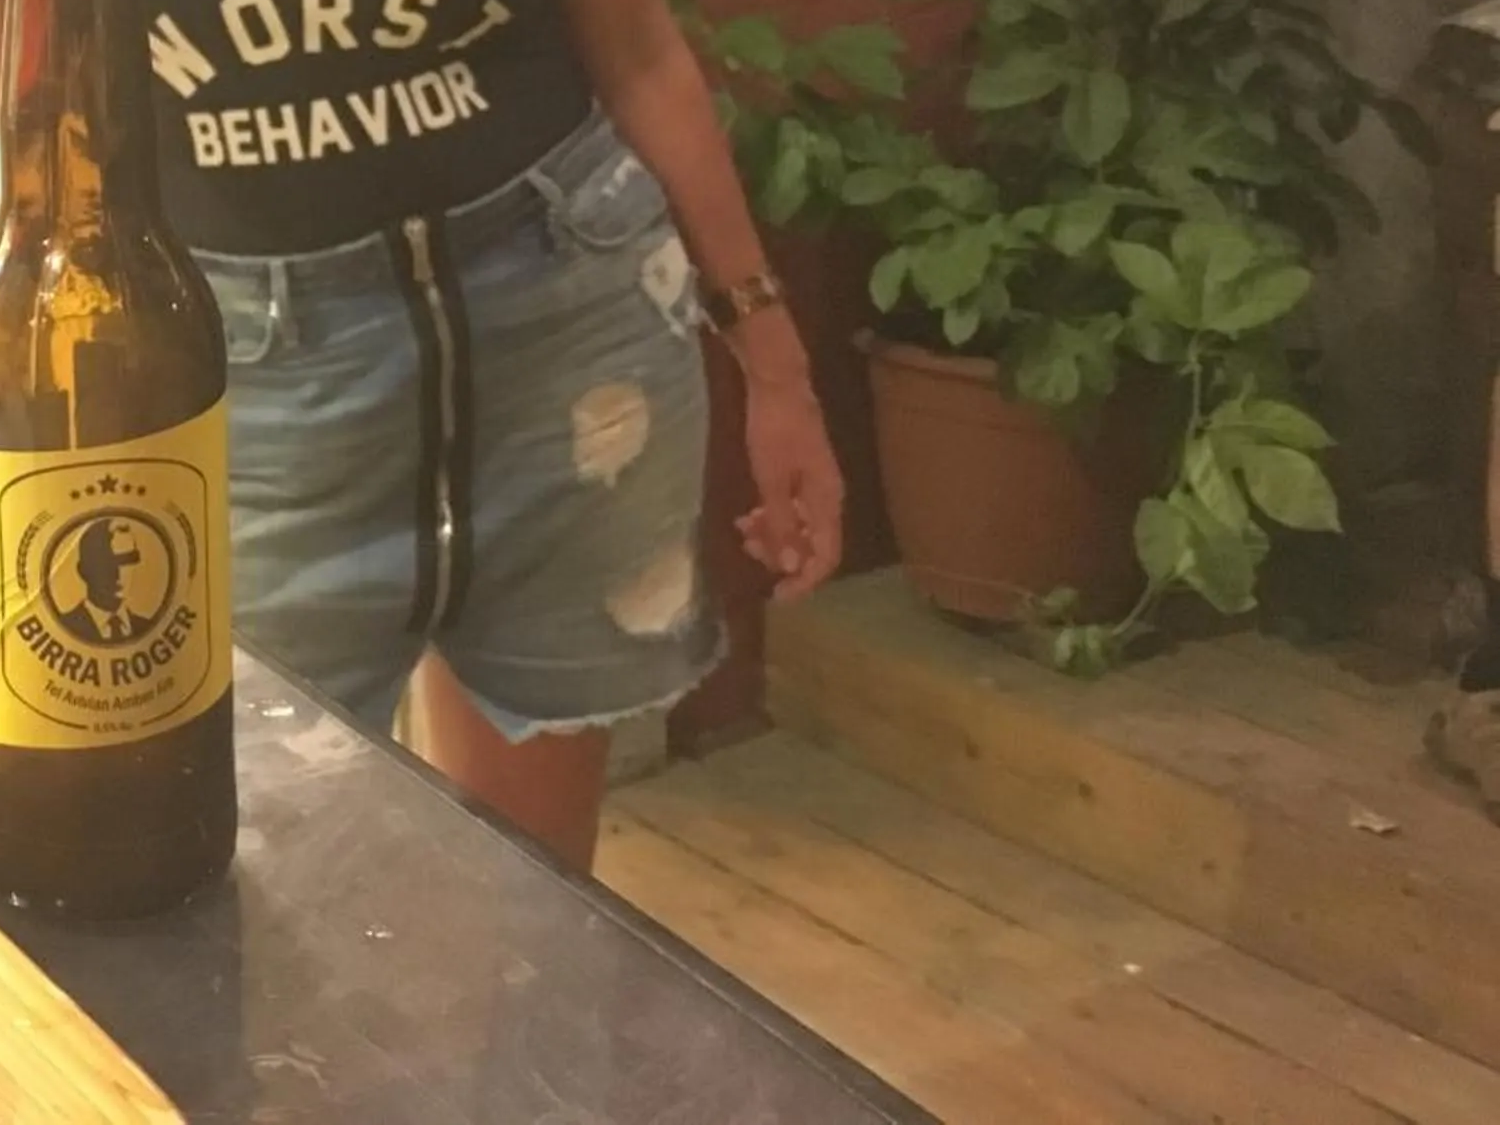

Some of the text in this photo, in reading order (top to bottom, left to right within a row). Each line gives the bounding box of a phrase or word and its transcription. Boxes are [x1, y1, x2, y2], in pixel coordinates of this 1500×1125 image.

[187, 60, 490, 167] BEHAVIOR
[16, 604, 198, 687] BIRRA ROGER
[43, 678, 64, 700] Tel
